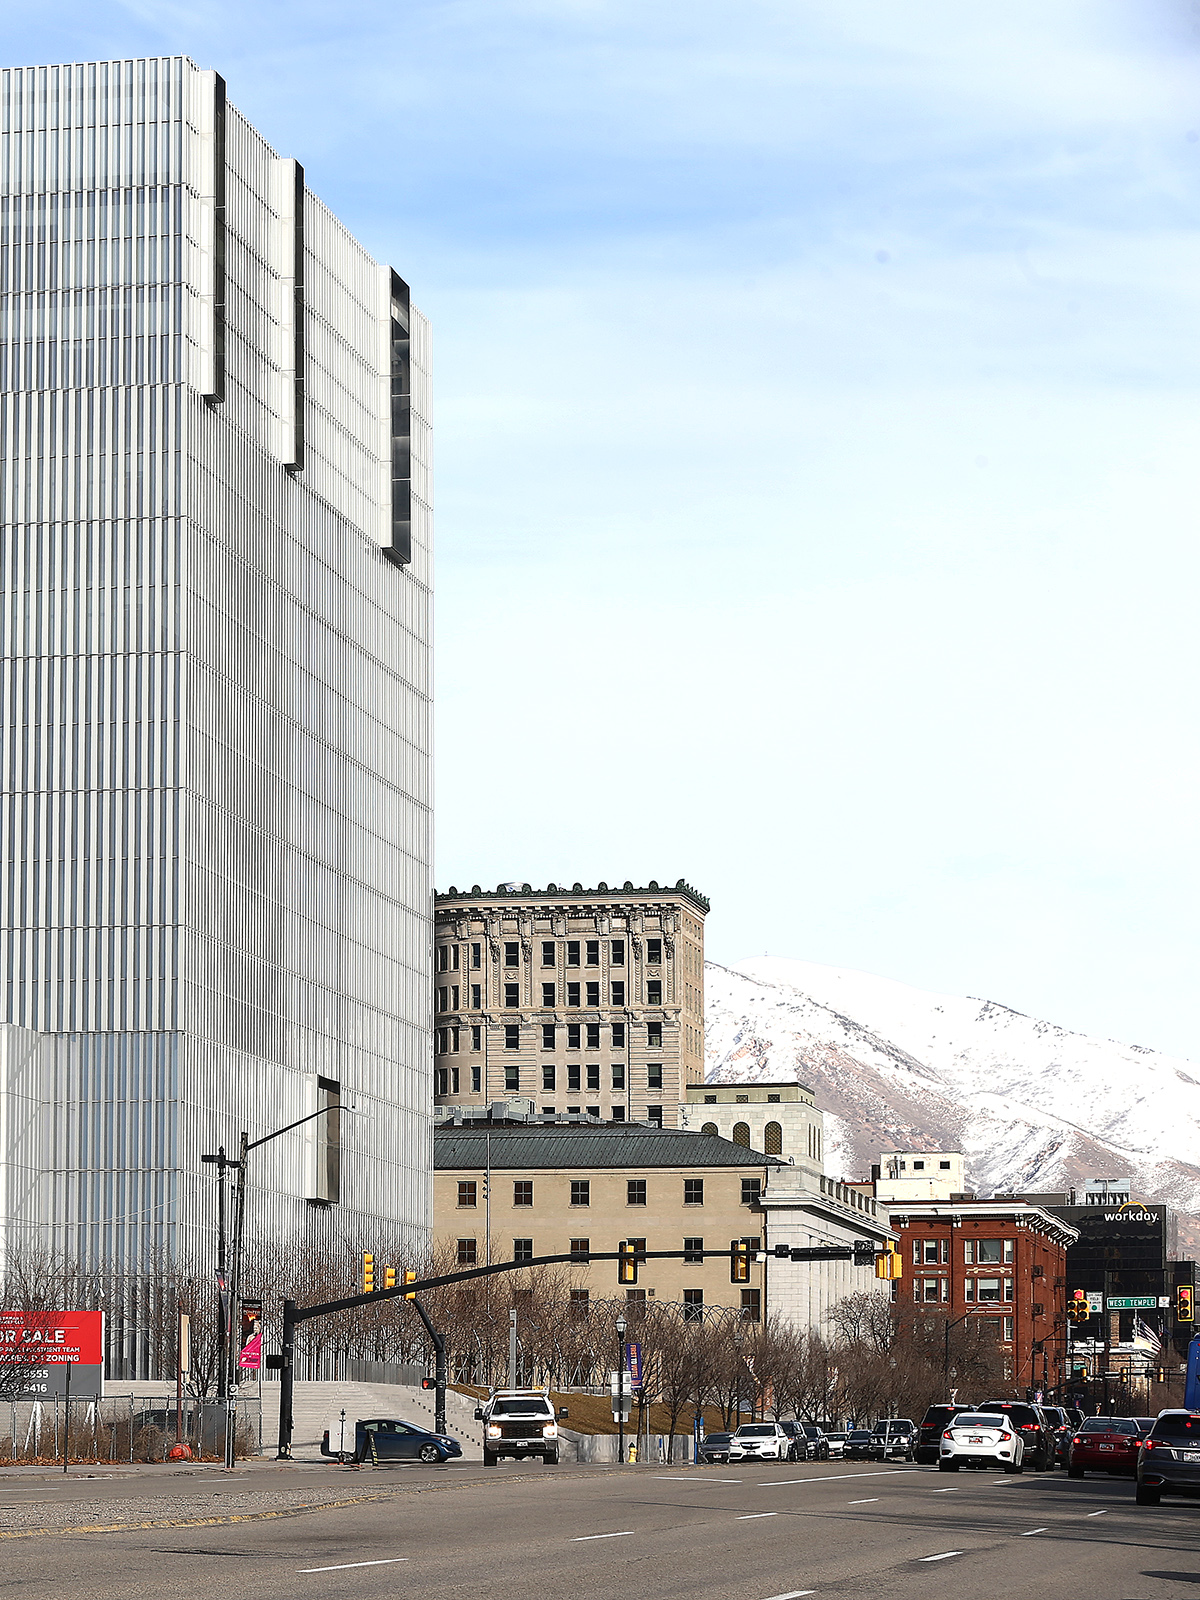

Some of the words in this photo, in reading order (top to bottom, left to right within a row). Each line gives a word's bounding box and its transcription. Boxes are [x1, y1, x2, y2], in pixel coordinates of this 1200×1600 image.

[1104, 1210, 1159, 1223] workday.
[1108, 1299, 1126, 1307] WEST
[1129, 1299, 1155, 1307] TEMPLE
[22, 1329, 65, 1344] SALE
[46, 1354, 80, 1362] ZONING
[631, 1365, 639, 1379] VOTE
[23, 1383, 48, 1393] 5416
